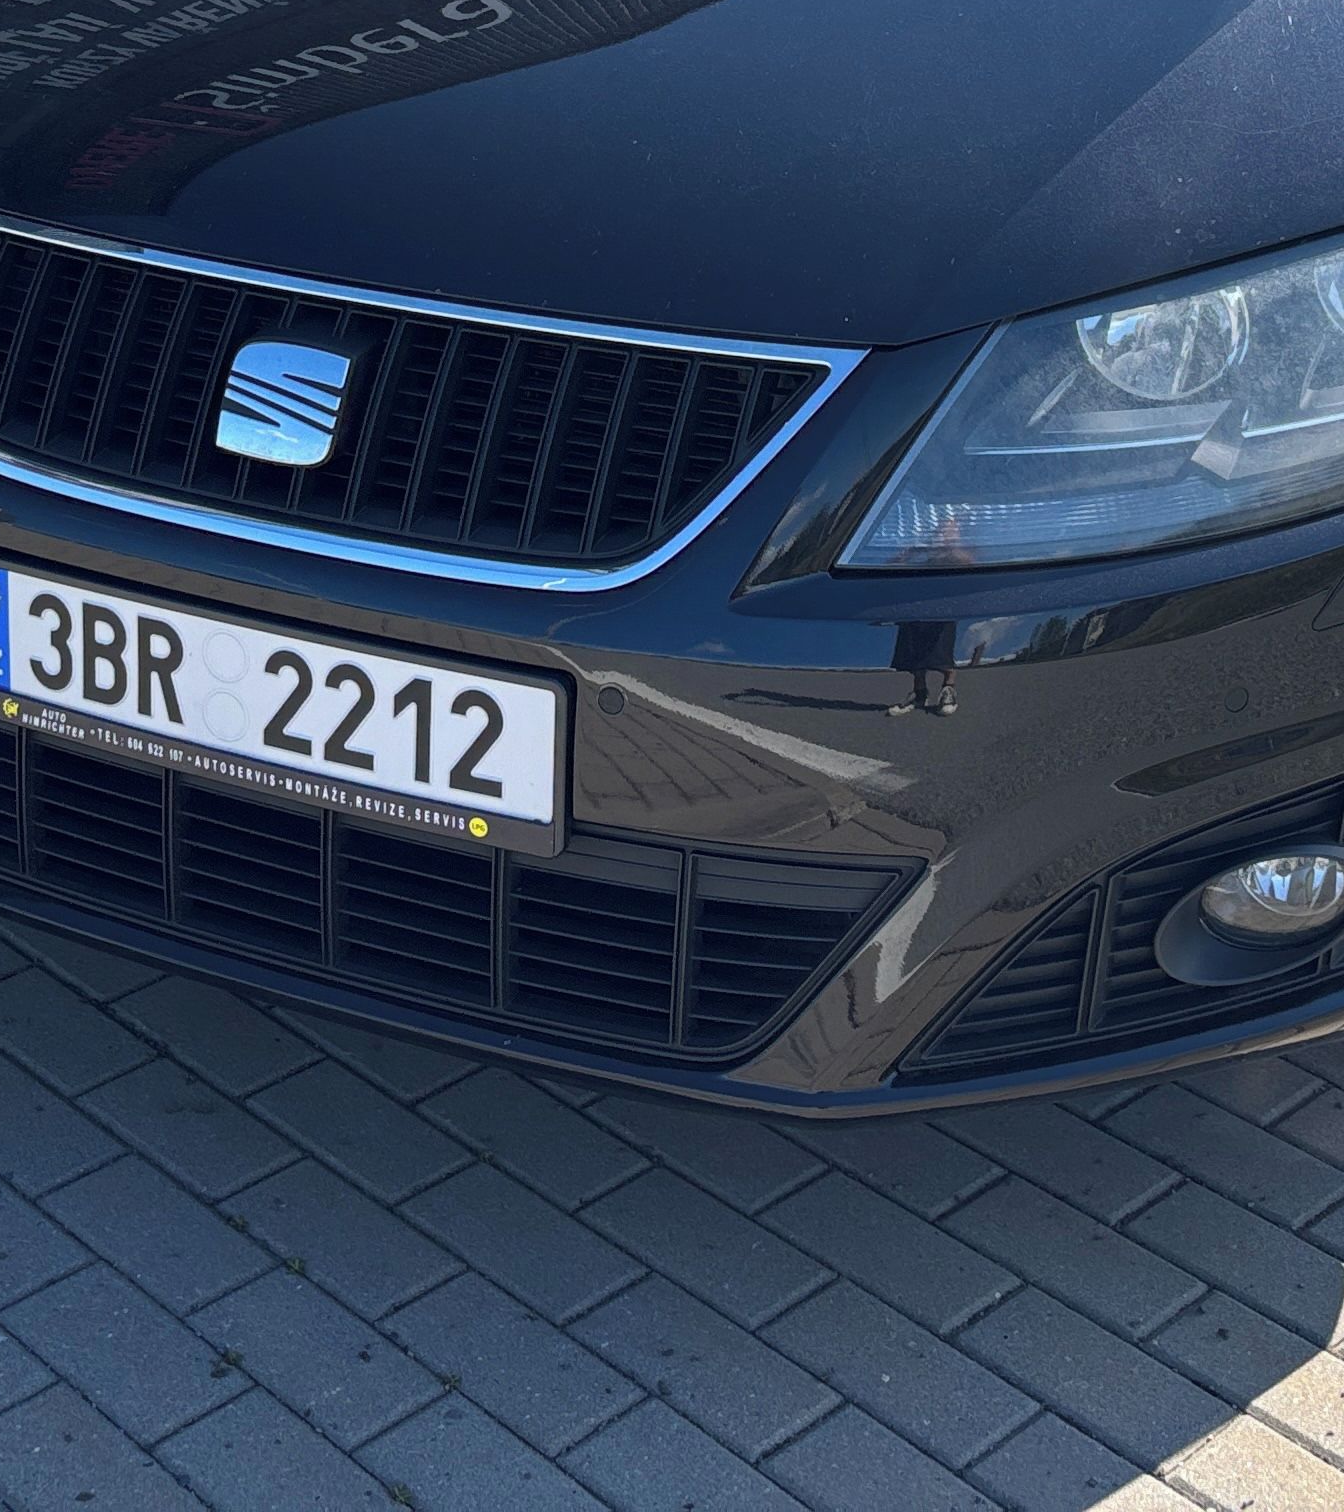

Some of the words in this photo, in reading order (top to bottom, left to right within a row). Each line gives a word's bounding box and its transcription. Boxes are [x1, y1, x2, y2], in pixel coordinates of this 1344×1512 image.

[27, 592, 185, 725] 3BR
[263, 649, 505, 800] 2212
[41, 707, 67, 724] AUTO
[194, 755, 276, 787] AUTOSERVIS
